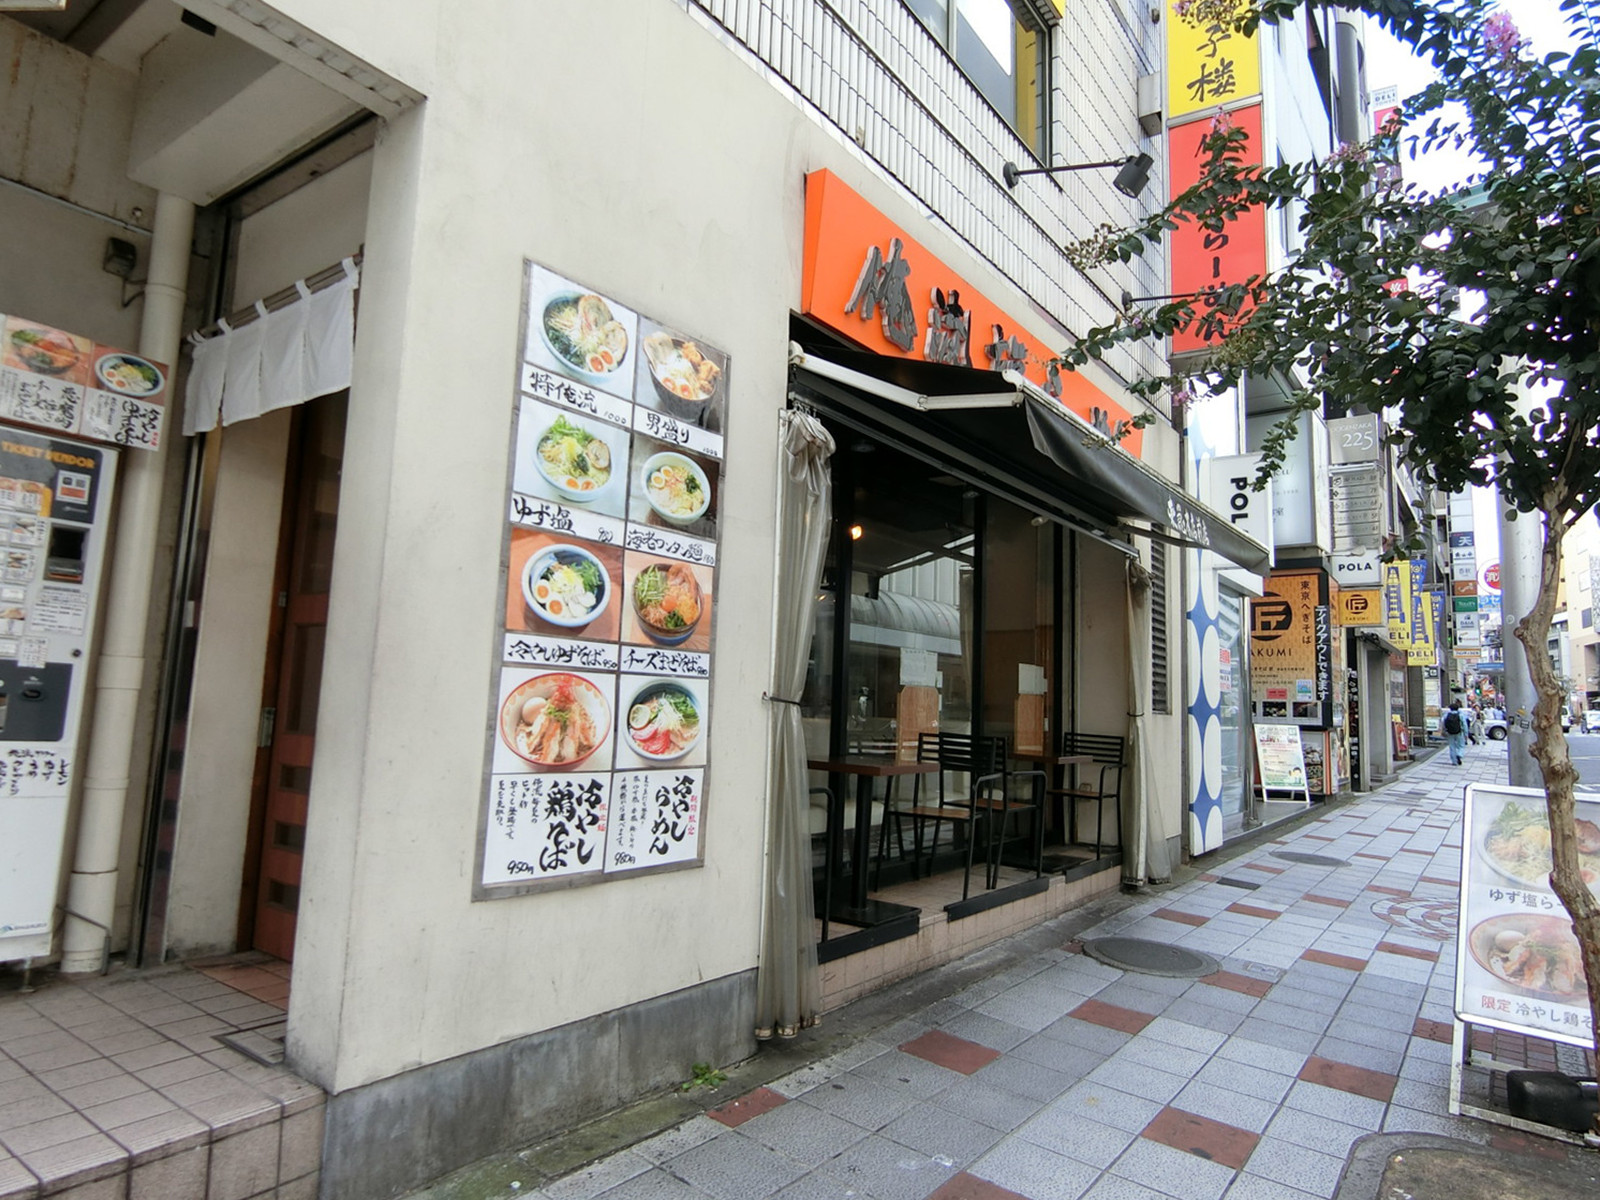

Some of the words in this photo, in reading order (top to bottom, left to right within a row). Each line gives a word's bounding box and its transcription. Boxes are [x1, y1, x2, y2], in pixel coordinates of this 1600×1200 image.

[647, 412, 690, 444] 男盛り
[1342, 430, 1374, 451] 225
[513, 496, 577, 536] ゆず塩
[1230, 477, 1249, 533] POL
[1338, 562, 1373, 573] POLA
[1300, 580, 1312, 645] 東京へぎそば
[508, 639, 604, 667] 冷やしゆずそば
[623, 648, 701, 673] チーズまぜそば
[1315, 605, 1330, 701] テイクアウトできます
[1408, 650, 1434, 658] DELI
[575, 778, 604, 865] 冷やし
[648, 785, 671, 856] らーめん
[671, 775, 695, 842] 冷やし
[1481, 995, 1512, 1013] 限定
